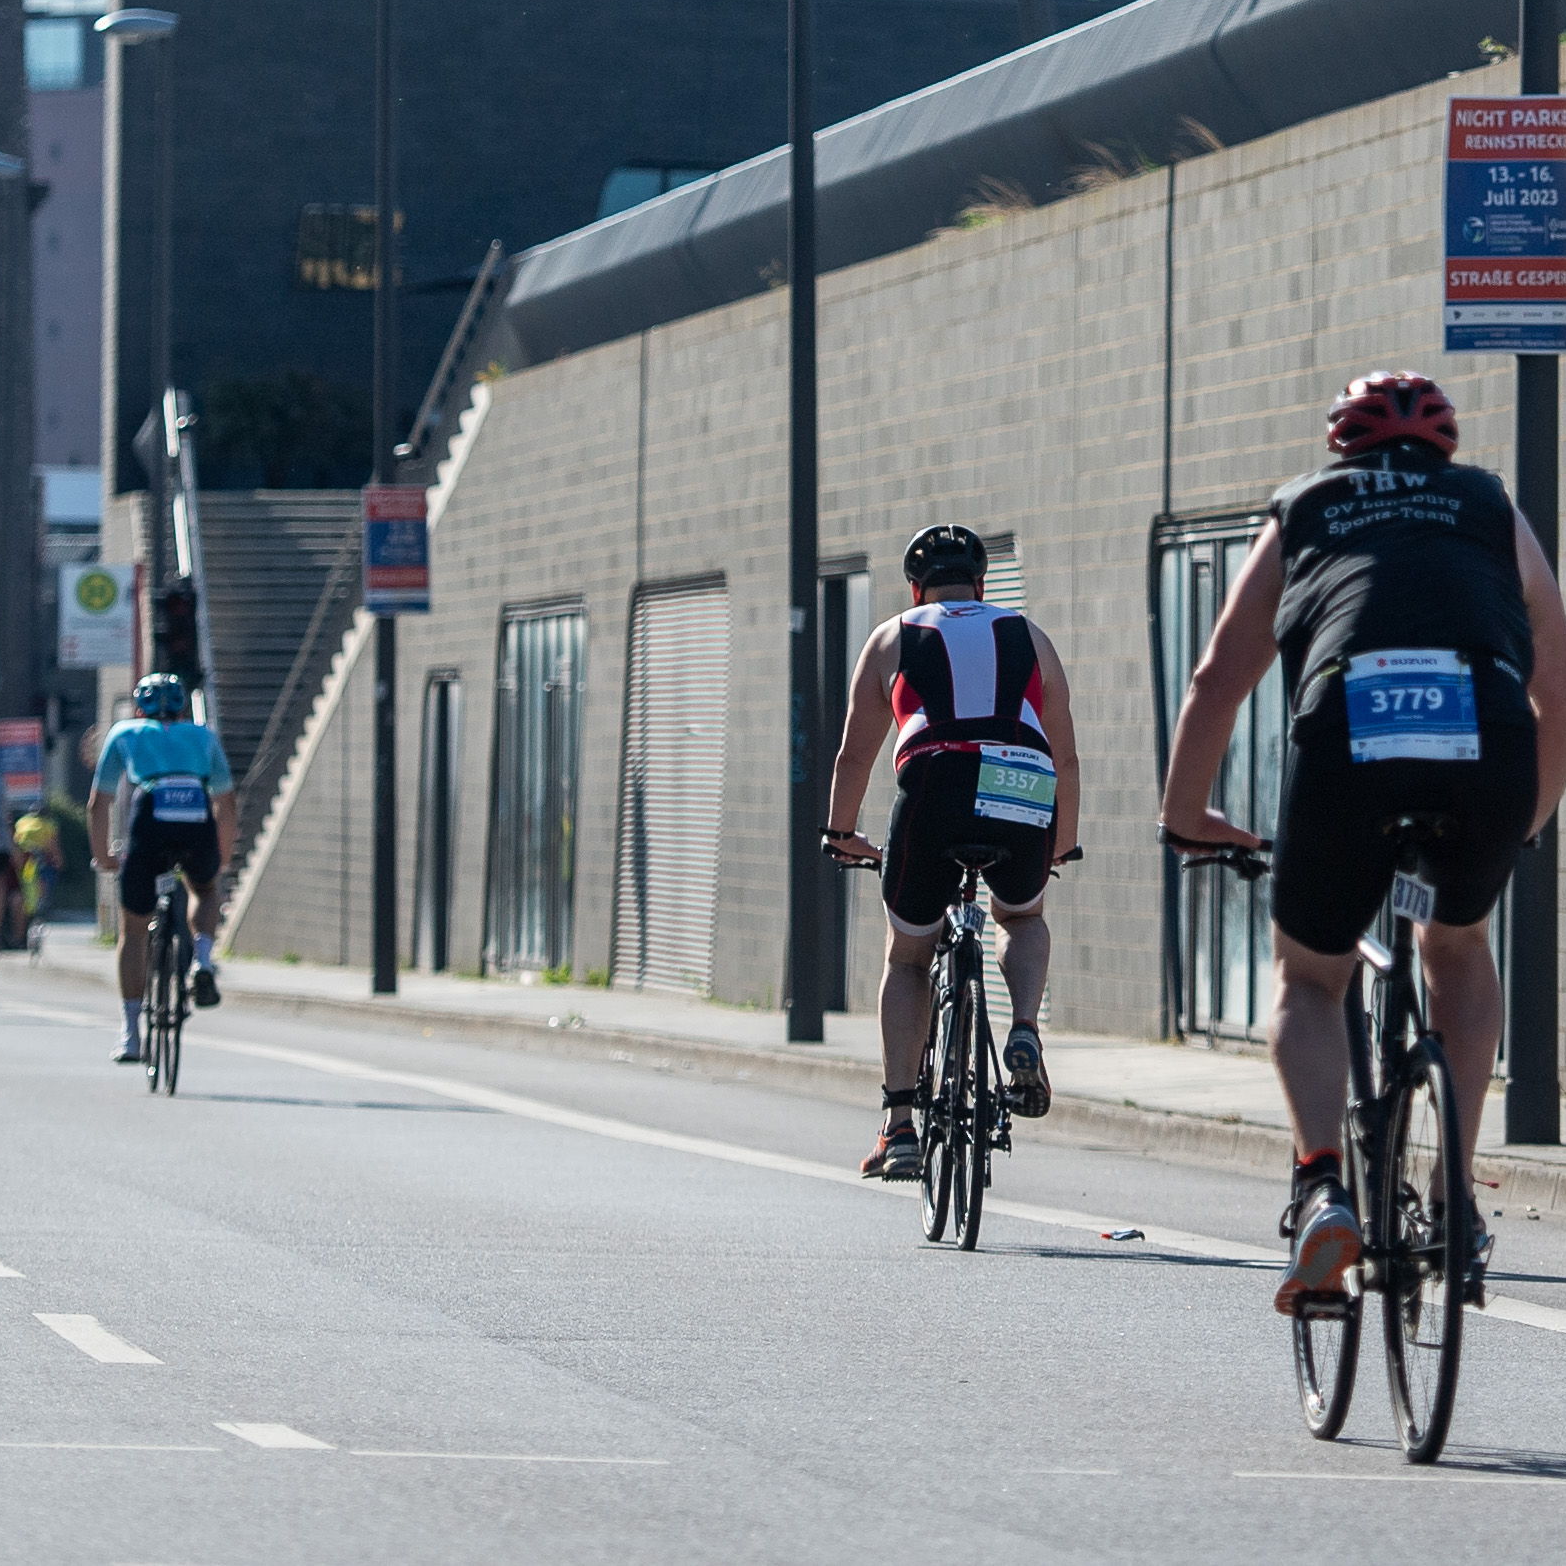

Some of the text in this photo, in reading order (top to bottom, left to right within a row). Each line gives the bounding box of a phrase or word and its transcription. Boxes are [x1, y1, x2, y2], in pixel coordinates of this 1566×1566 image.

[1456, 109, 1506, 127] NICHT
[1488, 166, 1515, 183] 13.
[1530, 166, 1554, 183] 16.
[1483, 188, 1558, 206] Juli 2023
[1348, 471, 1426, 495] THW
[1324, 502, 1355, 518] OV
[1371, 687, 1444, 713] 3779
[1010, 751, 1039, 761] SUZUKI
[994, 769, 1039, 791] 3357
[1394, 877, 1429, 919] 3779
